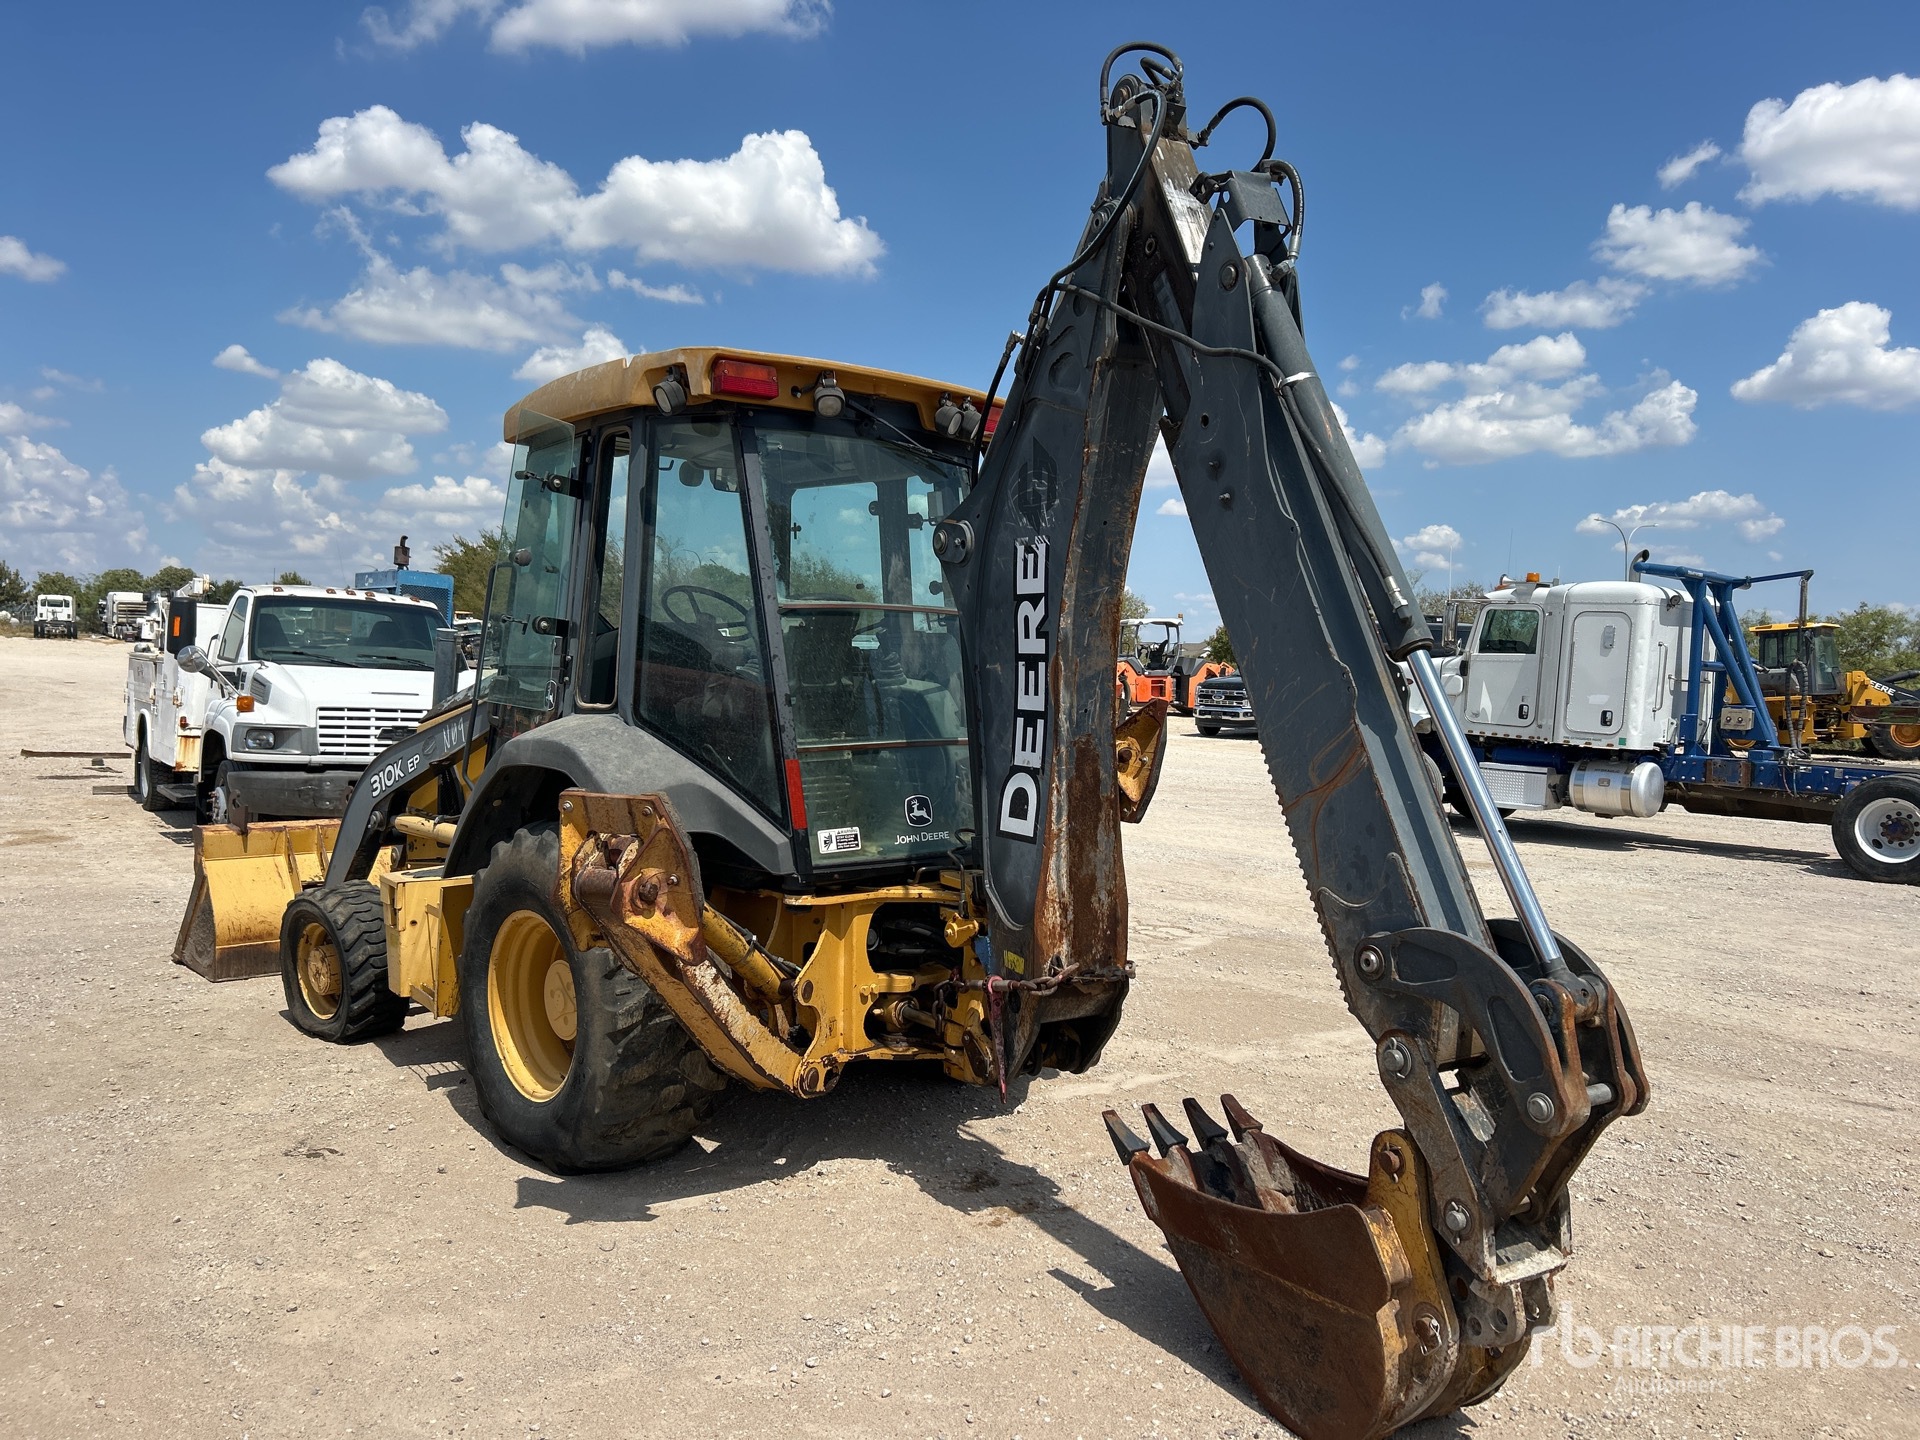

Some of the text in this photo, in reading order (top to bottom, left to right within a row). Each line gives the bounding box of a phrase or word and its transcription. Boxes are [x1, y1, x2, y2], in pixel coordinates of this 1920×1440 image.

[1000, 537, 1049, 837] DEERE
[1869, 680, 1896, 696] EERE
[370, 754, 420, 797] 310K EP
[895, 831, 950, 845] JOHN DEERE
